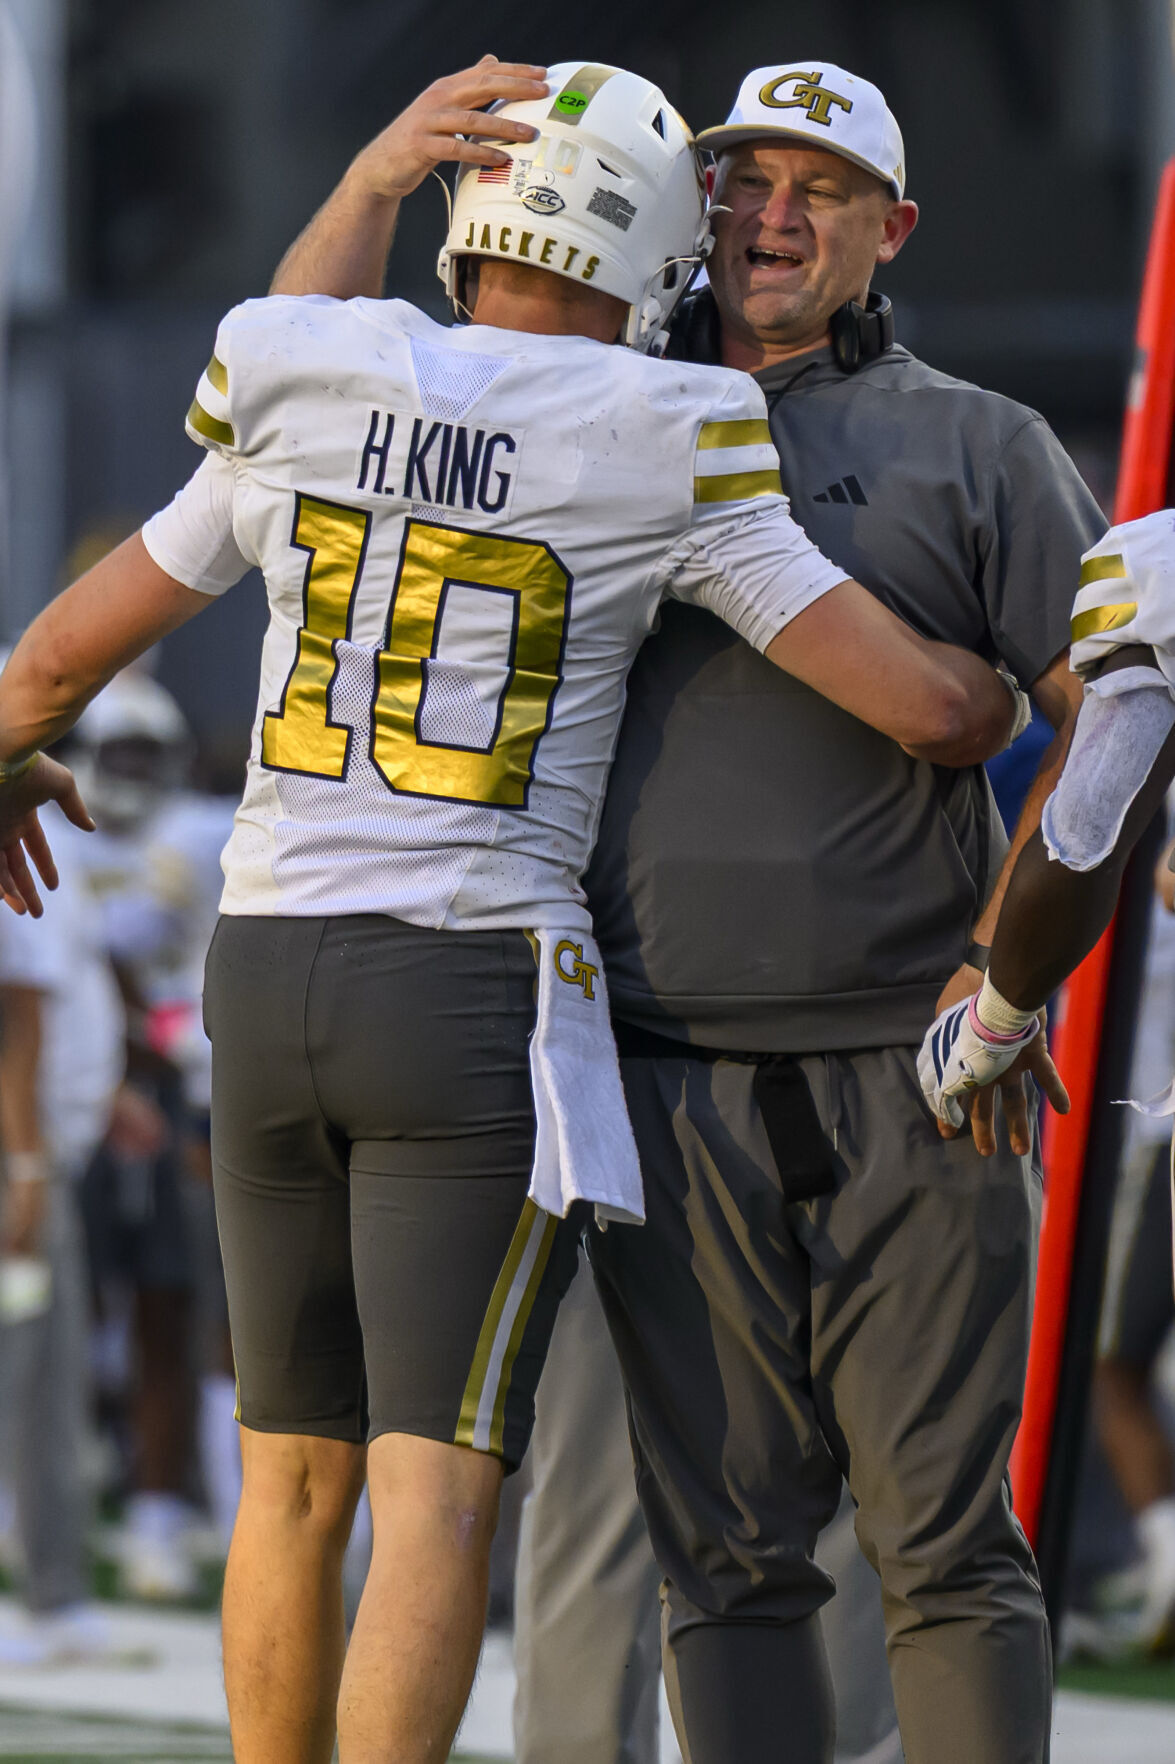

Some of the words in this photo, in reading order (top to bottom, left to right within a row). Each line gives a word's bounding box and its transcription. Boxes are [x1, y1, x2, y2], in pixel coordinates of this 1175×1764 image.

[559, 95, 586, 108] C2P
[758, 71, 853, 126] GT
[526, 191, 560, 207] ACC
[465, 222, 600, 280] JACKETS
[261, 490, 574, 811] 10
[554, 939, 599, 1001] GT
